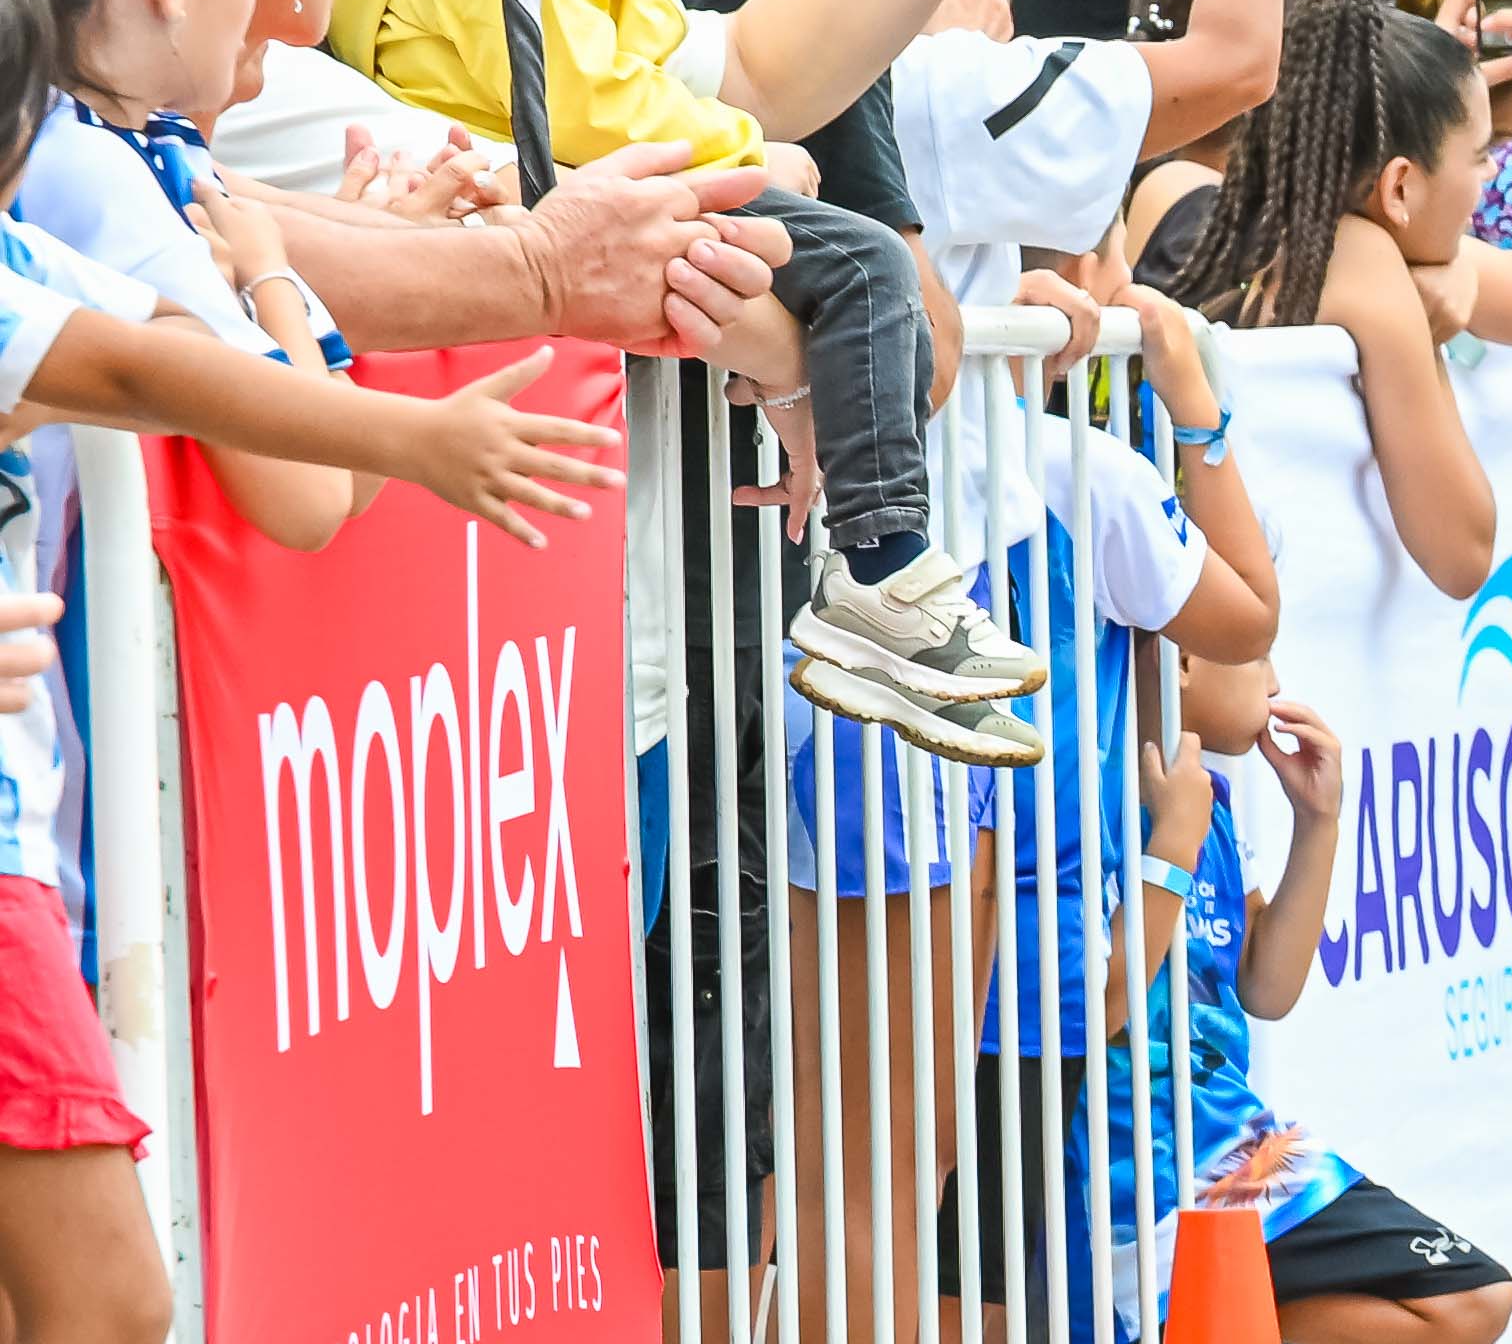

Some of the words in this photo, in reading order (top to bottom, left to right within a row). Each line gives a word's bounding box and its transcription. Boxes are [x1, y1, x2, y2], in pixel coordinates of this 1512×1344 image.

[257, 520, 585, 1116] moplex
[491, 1240, 537, 1333] TUS
[550, 1233, 602, 1314] PIES
